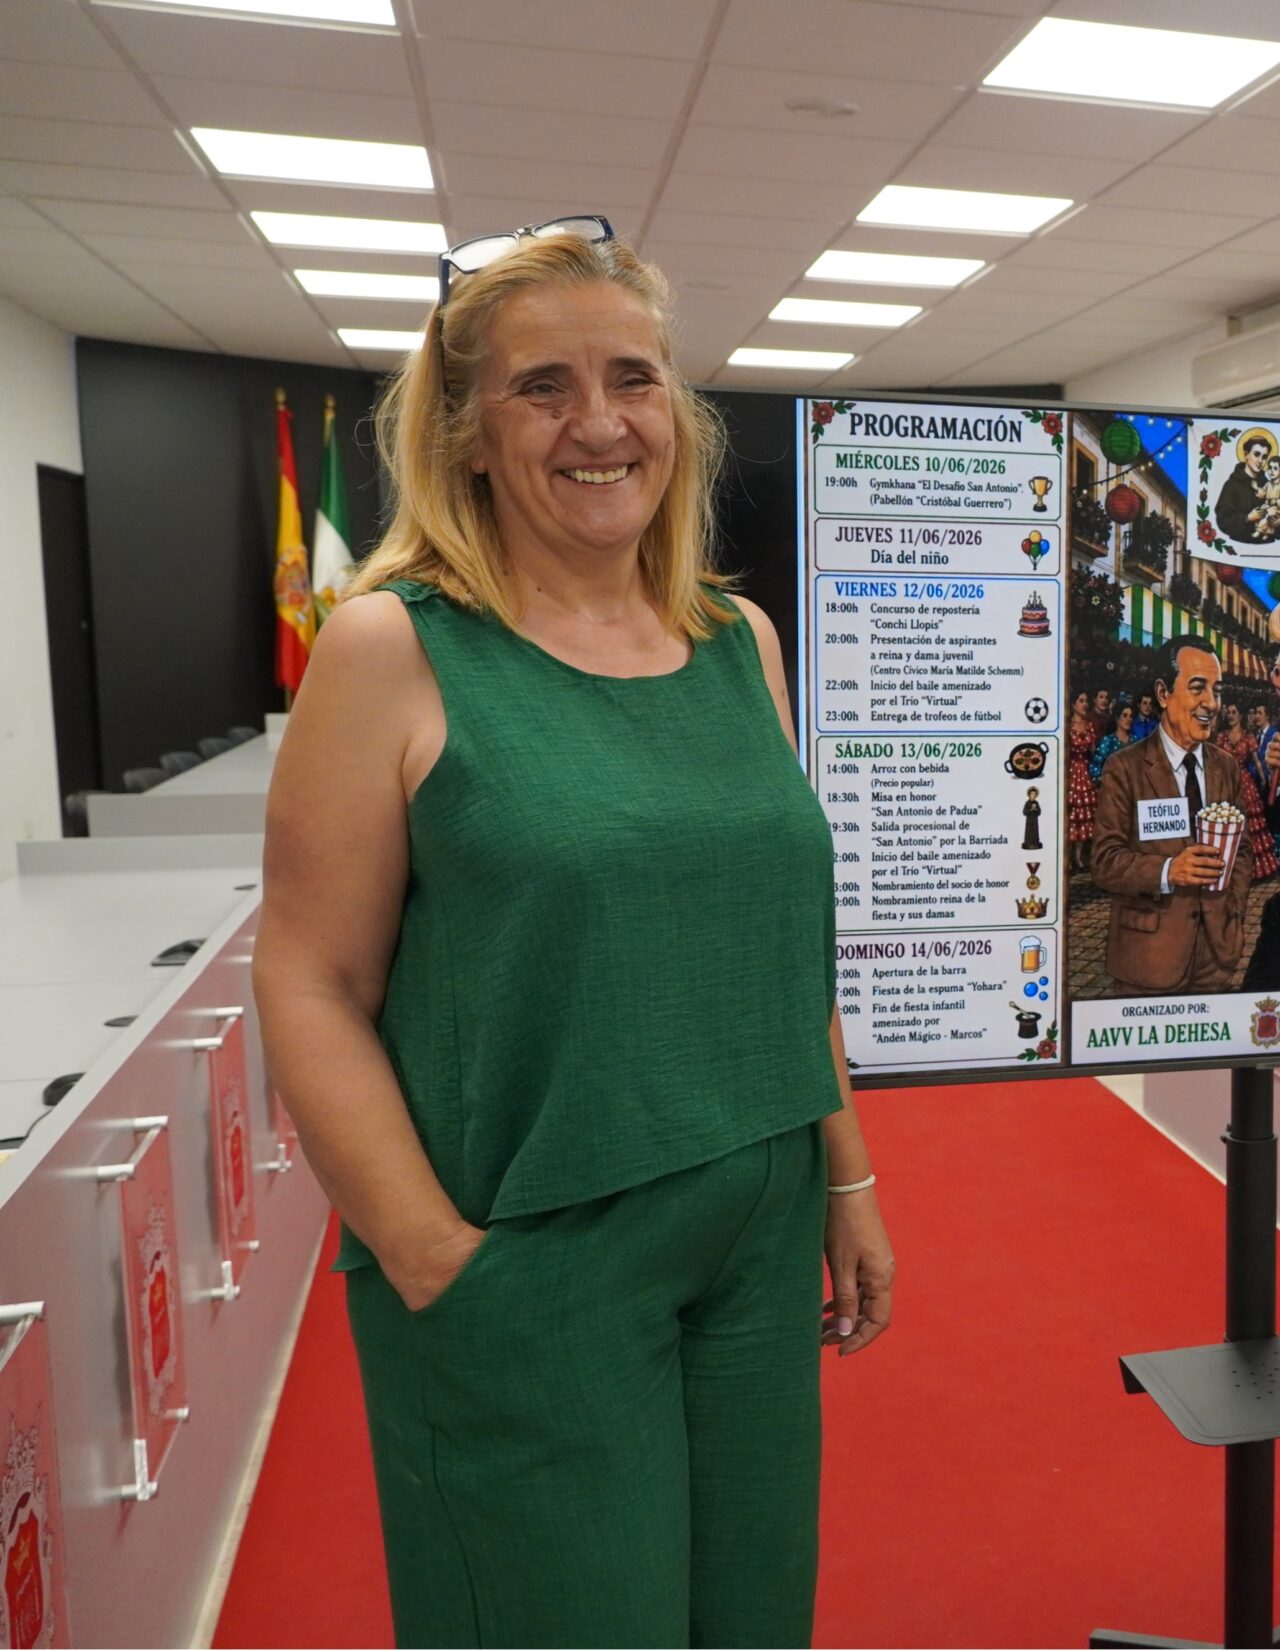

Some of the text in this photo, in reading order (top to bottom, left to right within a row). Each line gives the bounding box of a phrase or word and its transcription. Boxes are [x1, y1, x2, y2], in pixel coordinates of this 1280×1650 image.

[850, 413, 1022, 443] PROGRAMACIÓN
[835, 450, 1006, 475] MIÉRCOLES 10/06/2026
[824, 477, 983, 492] 19:00h Gymkhana San
[870, 496, 913, 506] (Pabellón
[835, 526, 983, 547] JUEVES 11/06/2026
[871, 549, 949, 565] Día del niño
[835, 581, 984, 600] VIERNES 12/06/2026
[825, 603, 980, 617] 18:00h Concurso de repostería
[825, 634, 997, 647] 20:00h Presentación de aspirantes
[870, 650, 974, 663] a reina y dama juvenil
[870, 665, 901, 676] (Centro
[956, 666, 986, 676] Matilde
[825, 680, 992, 691] 22:00h Inicio del baile amenizado
[870, 697, 887, 709] por
[890, 695, 898, 706] el
[825, 710, 1002, 724] 23:00h Entrega de trofeos de fútbol
[835, 740, 982, 760] SÁBADO 13/06/2026
[826, 764, 949, 774] 14:00h Arroz con bebida
[871, 778, 934, 789] (Precio popular)
[826, 792, 937, 803] 18:30h Misa en honor
[896, 806, 934, 817] Antonio
[936, 806, 947, 816] de
[1148, 804, 1180, 818] TEÓFILO
[872, 821, 970, 833] Salida procesional de
[1143, 819, 1186, 833] HERNANDO
[940, 837, 956, 847] por
[958, 836, 967, 845] la
[969, 836, 1008, 845] Barriada
[872, 851, 992, 862] Inicio del baile amenizado
[872, 867, 889, 879] por
[891, 866, 900, 876] el
[872, 880, 1010, 892] Nombramiento del socio de honor
[872, 894, 986, 907] Nombramiento reina de la
[872, 909, 955, 921] fiesta sus damas
[836, 940, 992, 961] DOMINGO 14/06/2026
[872, 965, 967, 978] Apertura de la barra
[872, 985, 900, 996] Fiesta
[903, 985, 915, 995] de
[917, 984, 926, 994] la
[929, 984, 964, 995] espuma
[872, 1000, 965, 1014] Fin de fiesta infantil
[1122, 1002, 1210, 1017] ORGANIZADO POR:
[872, 1016, 940, 1028] amenizado por
[909, 1030, 941, 1044] Mágico
[1086, 1021, 1231, 1048] AAVV LA DEHESA
